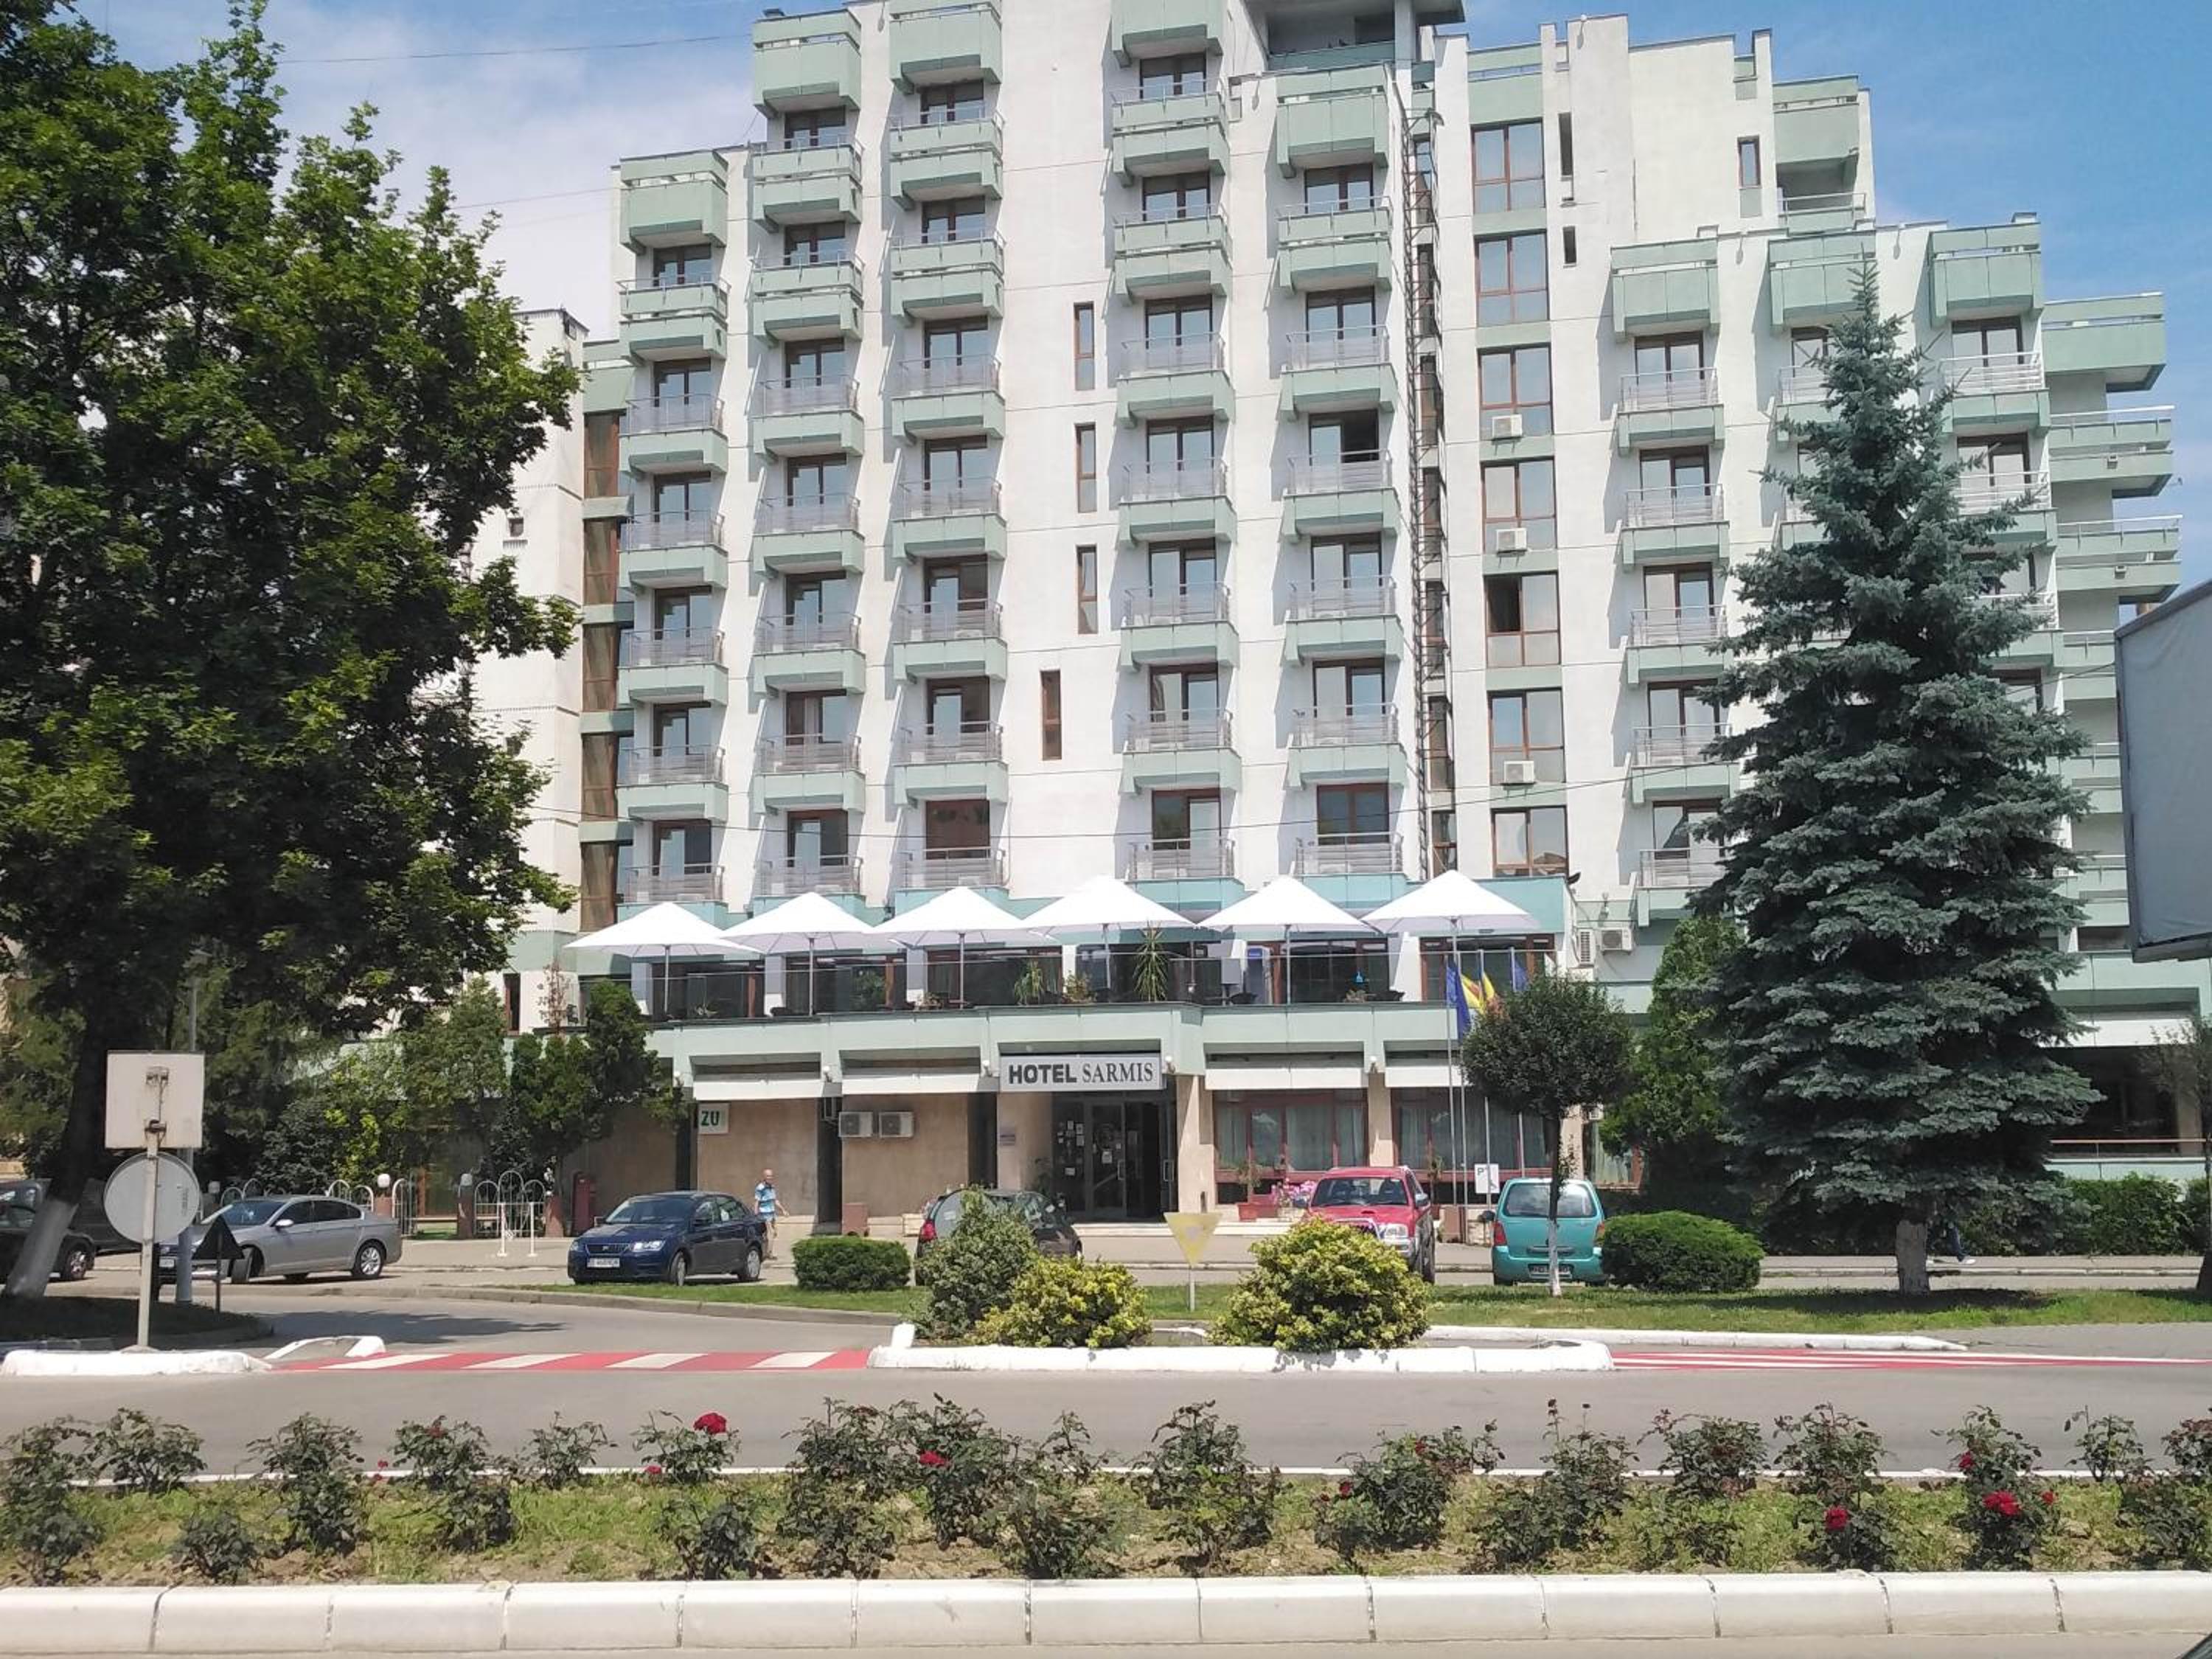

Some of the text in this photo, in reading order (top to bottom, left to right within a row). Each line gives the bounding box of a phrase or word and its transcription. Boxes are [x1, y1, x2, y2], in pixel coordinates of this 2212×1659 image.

[1009, 1062, 1154, 1084] HOTEL SARMIS
[701, 1110, 720, 1126] ZU
